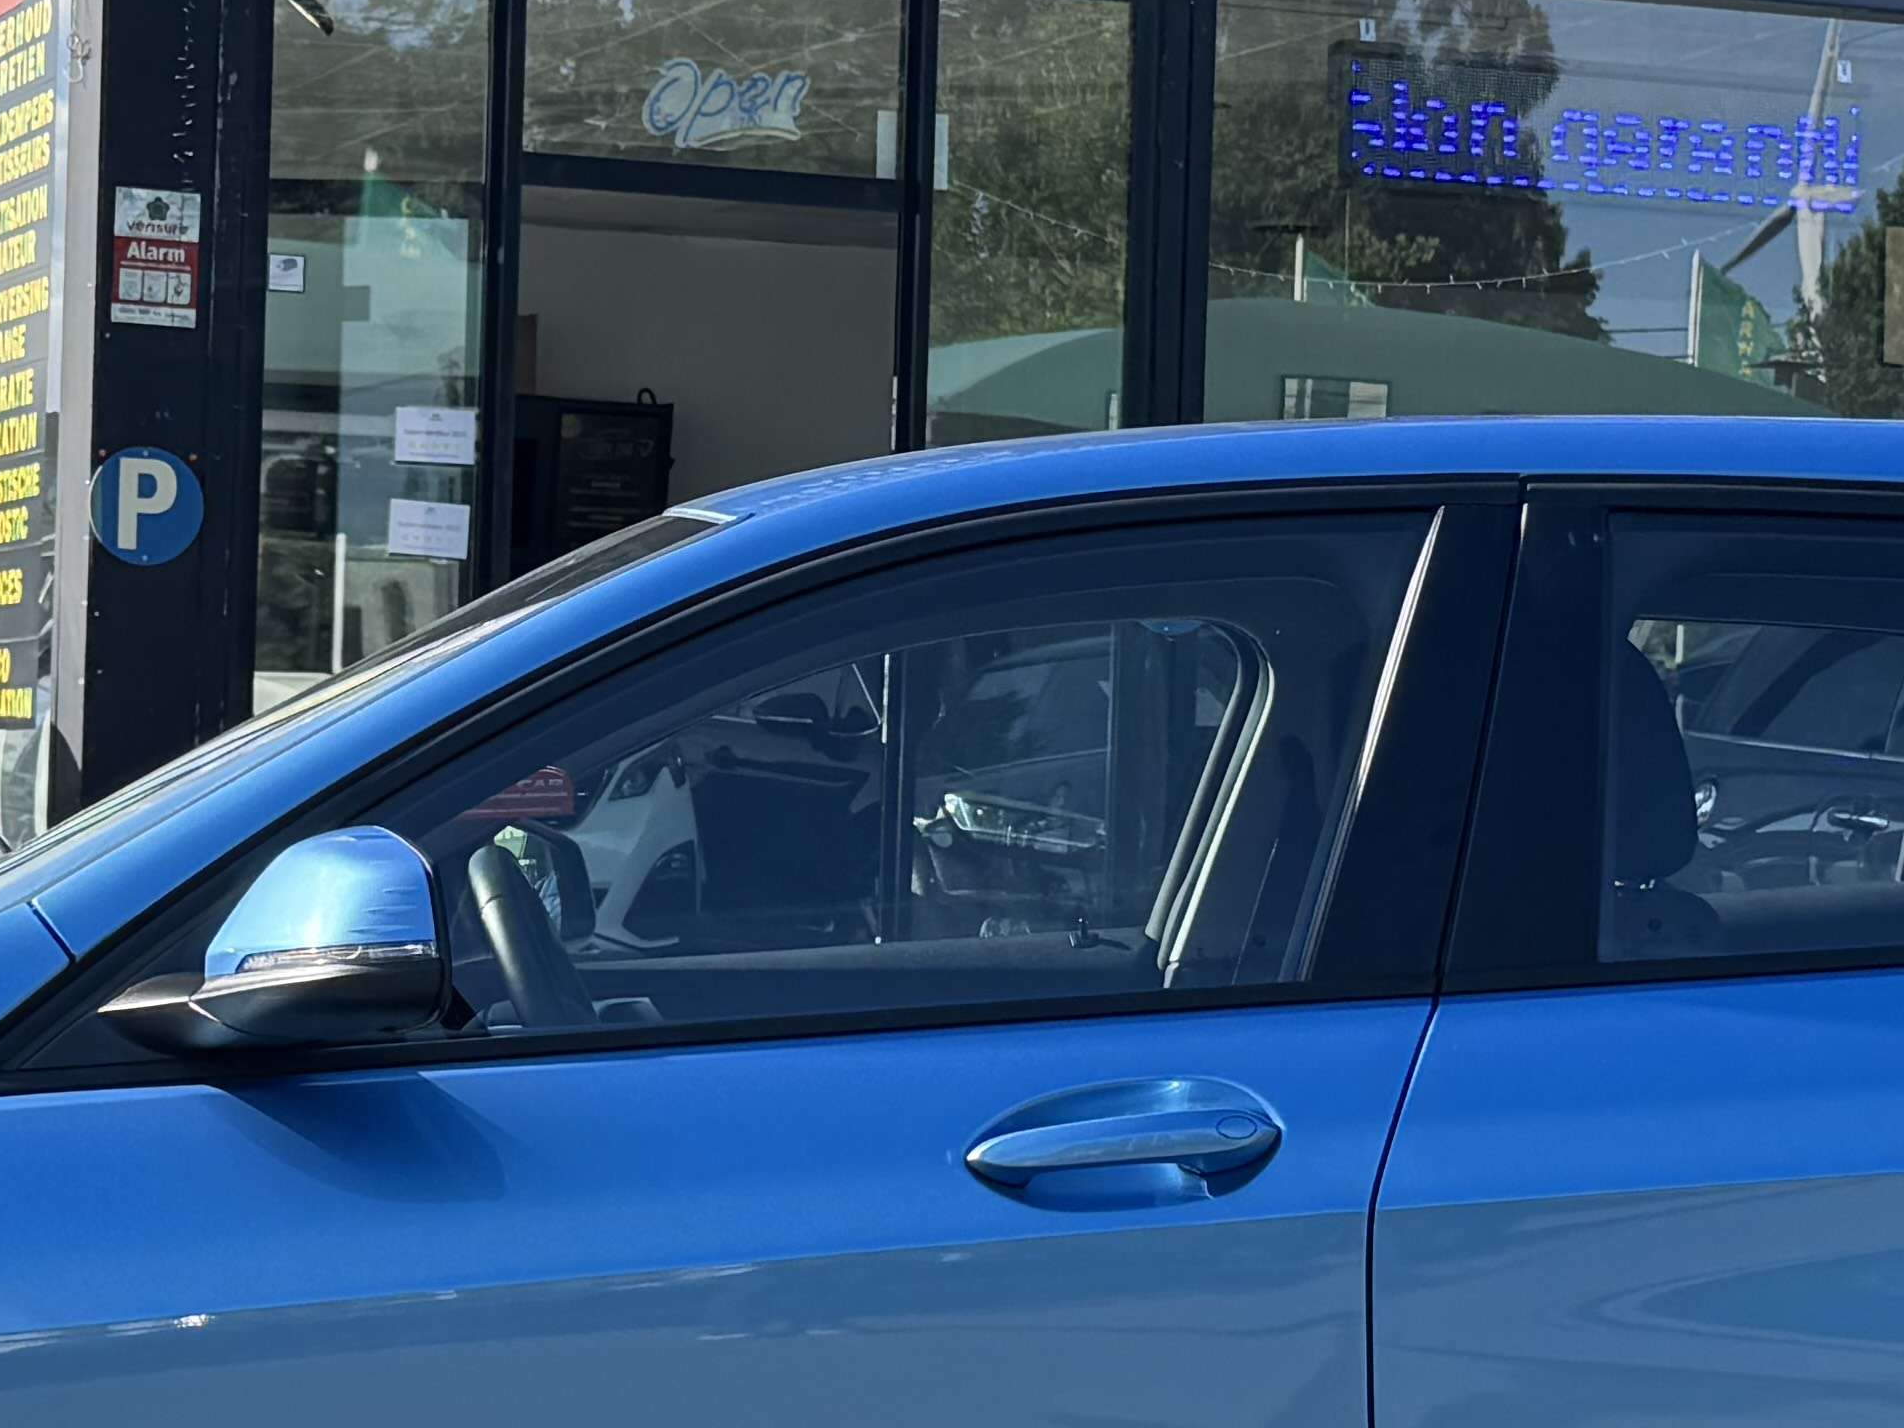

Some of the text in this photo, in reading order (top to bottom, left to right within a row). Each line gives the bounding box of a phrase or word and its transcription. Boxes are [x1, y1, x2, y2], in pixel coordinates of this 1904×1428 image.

[645, 58, 809, 147] Open
[126, 240, 186, 263] Alarm
[117, 456, 178, 551] P
